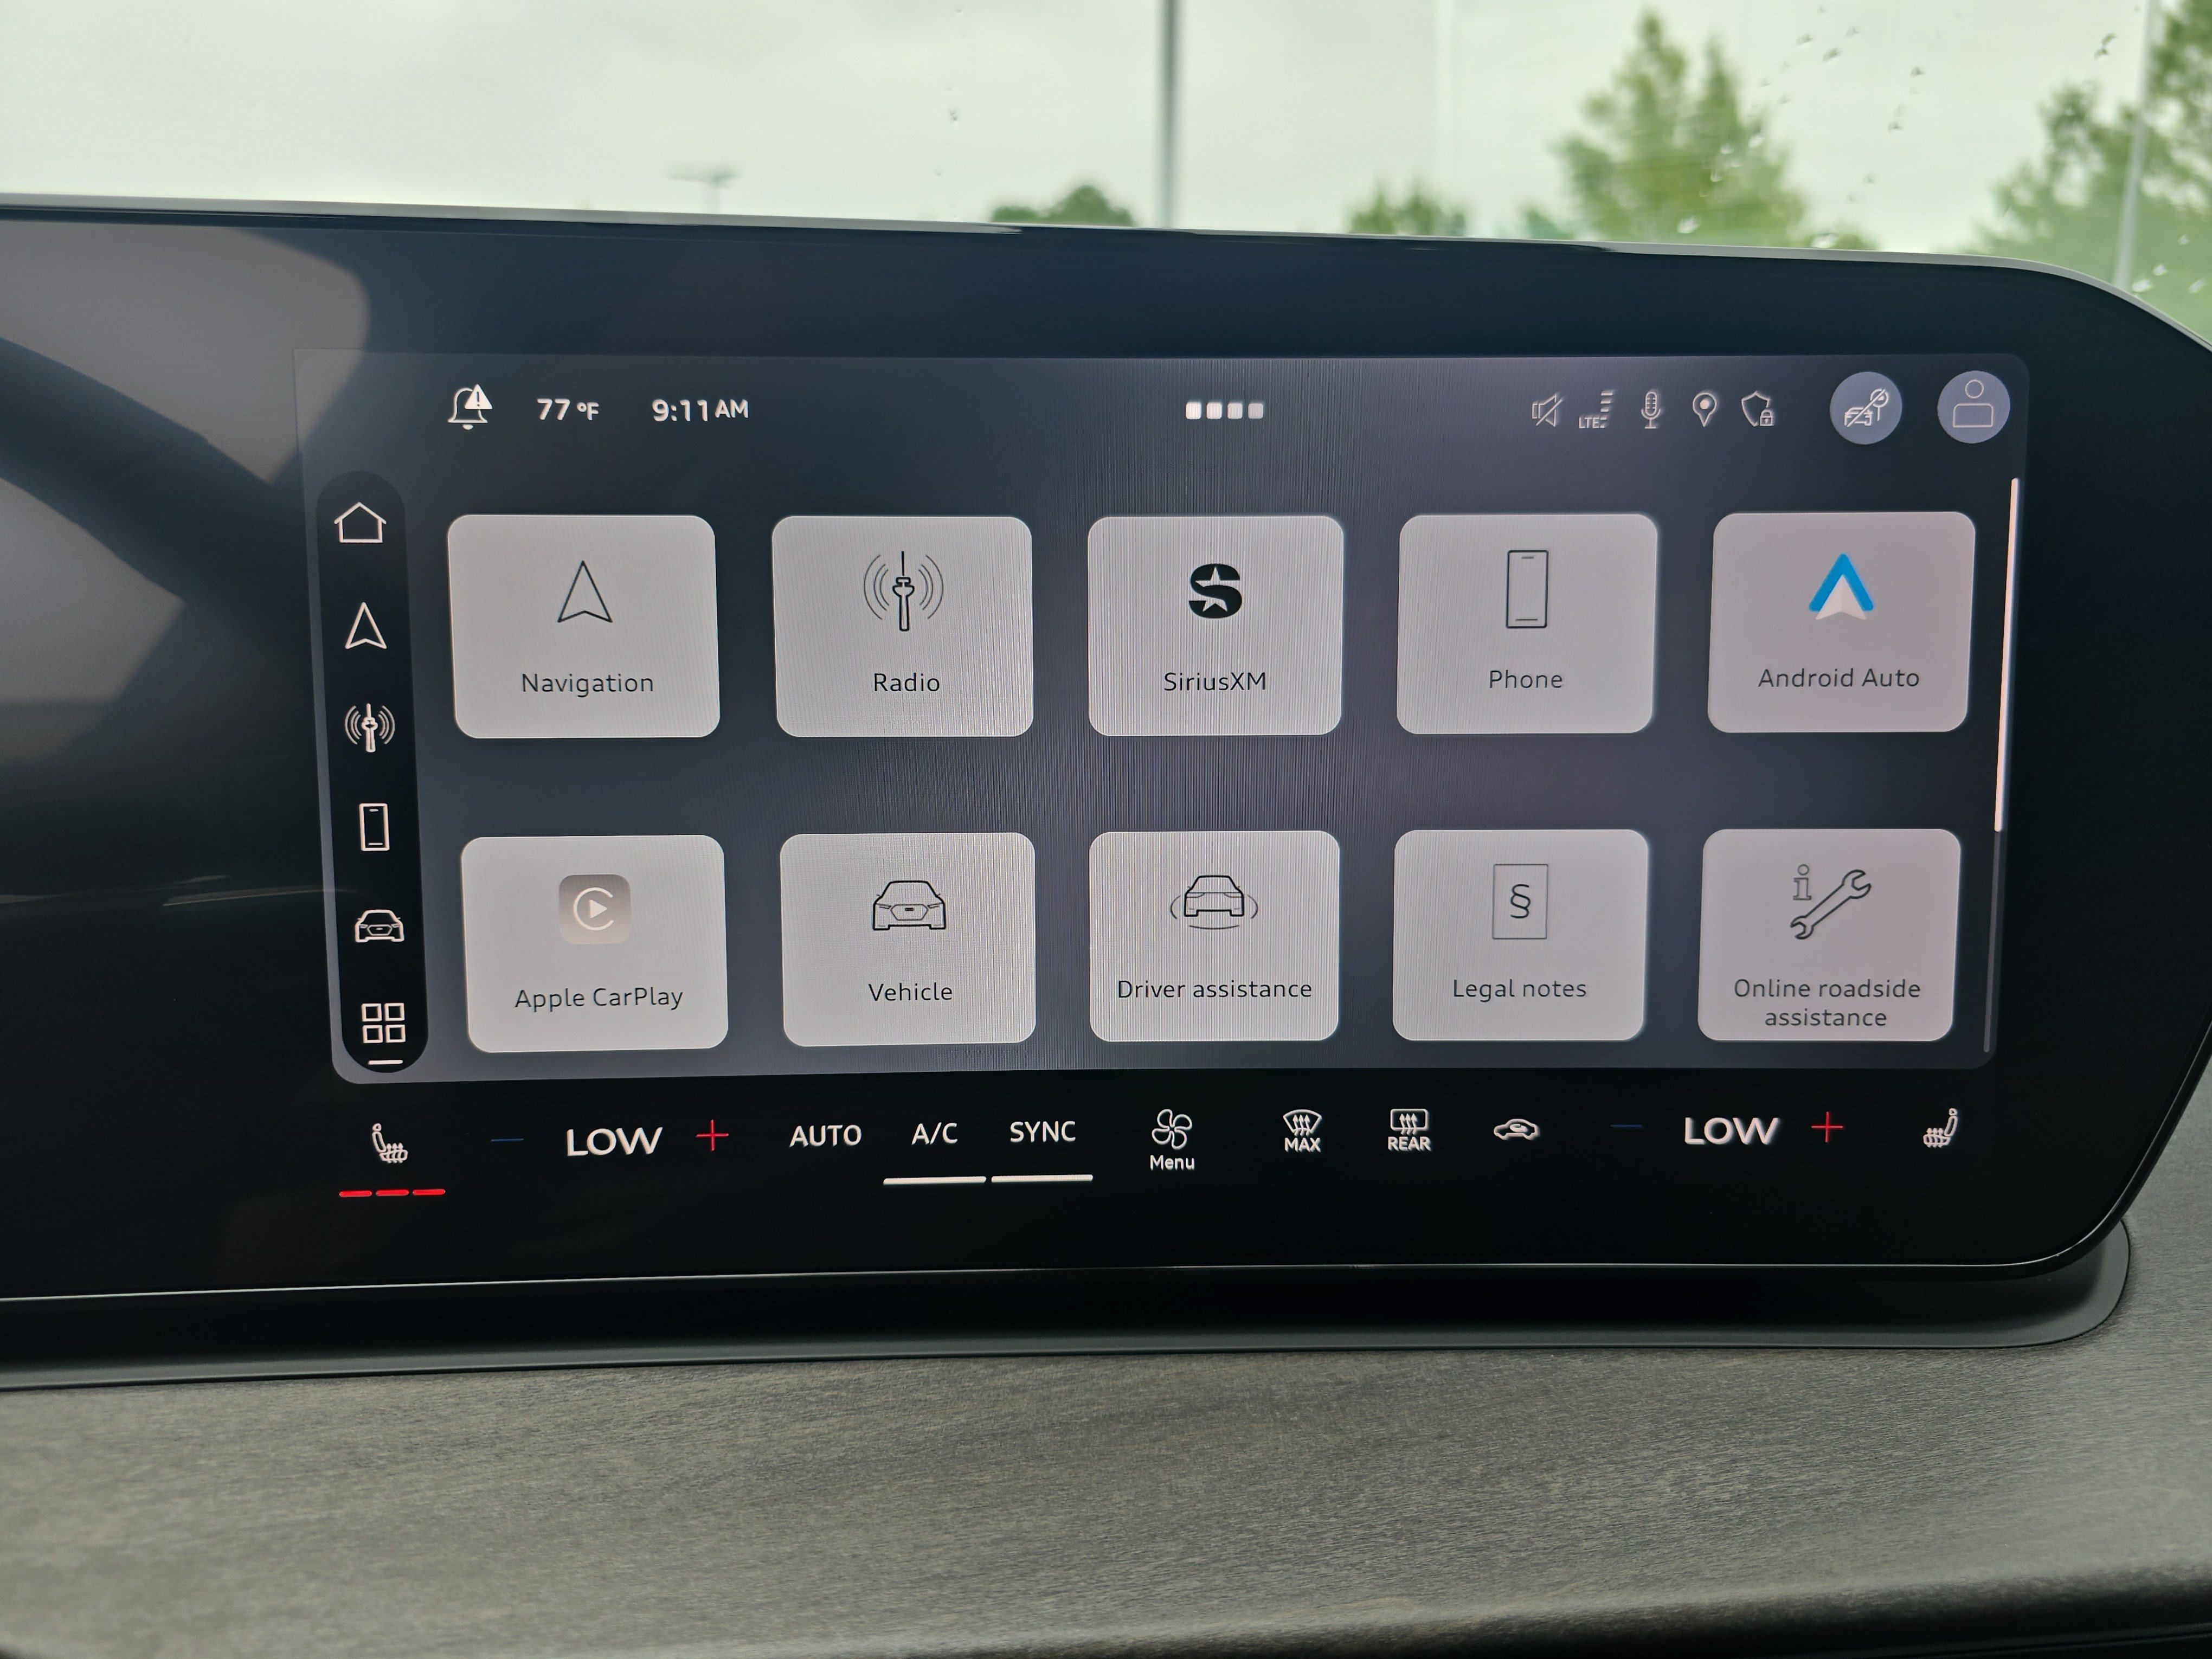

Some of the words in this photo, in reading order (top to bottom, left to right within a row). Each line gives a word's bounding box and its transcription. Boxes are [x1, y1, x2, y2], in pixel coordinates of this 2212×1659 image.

[537, 398, 570, 420] 77
[652, 399, 708, 422] 9:11
[715, 399, 749, 418] AM
[1578, 416, 1600, 429] LTE
[522, 673, 653, 698] Navigation
[874, 672, 940, 692] Radio
[1164, 672, 1266, 691] SiriusXM
[1489, 670, 1563, 689] Phone
[1758, 667, 1854, 687] Android
[1862, 668, 1920, 687] Auto
[868, 982, 953, 1001] Vehicle
[1118, 980, 1186, 998] Driver
[1193, 980, 1312, 998] assistance
[1454, 979, 1515, 1003] Legal
[1523, 981, 1587, 998] notes
[1734, 979, 1811, 998] Online
[1819, 979, 1921, 998] roadside
[515, 988, 584, 1013] Apple
[593, 987, 683, 1011] CarPlay
[1765, 1008, 1887, 1027] assistance
[789, 1124, 862, 1147] AUTO
[911, 1122, 957, 1144] A/C
[1010, 1121, 1076, 1143] SYNC
[1684, 1117, 1779, 1144] LOW
[567, 1127, 663, 1156] LOW
[1284, 1137, 1321, 1152] MAX
[1388, 1136, 1430, 1150] REAR
[1150, 1155, 1195, 1170] Menu
